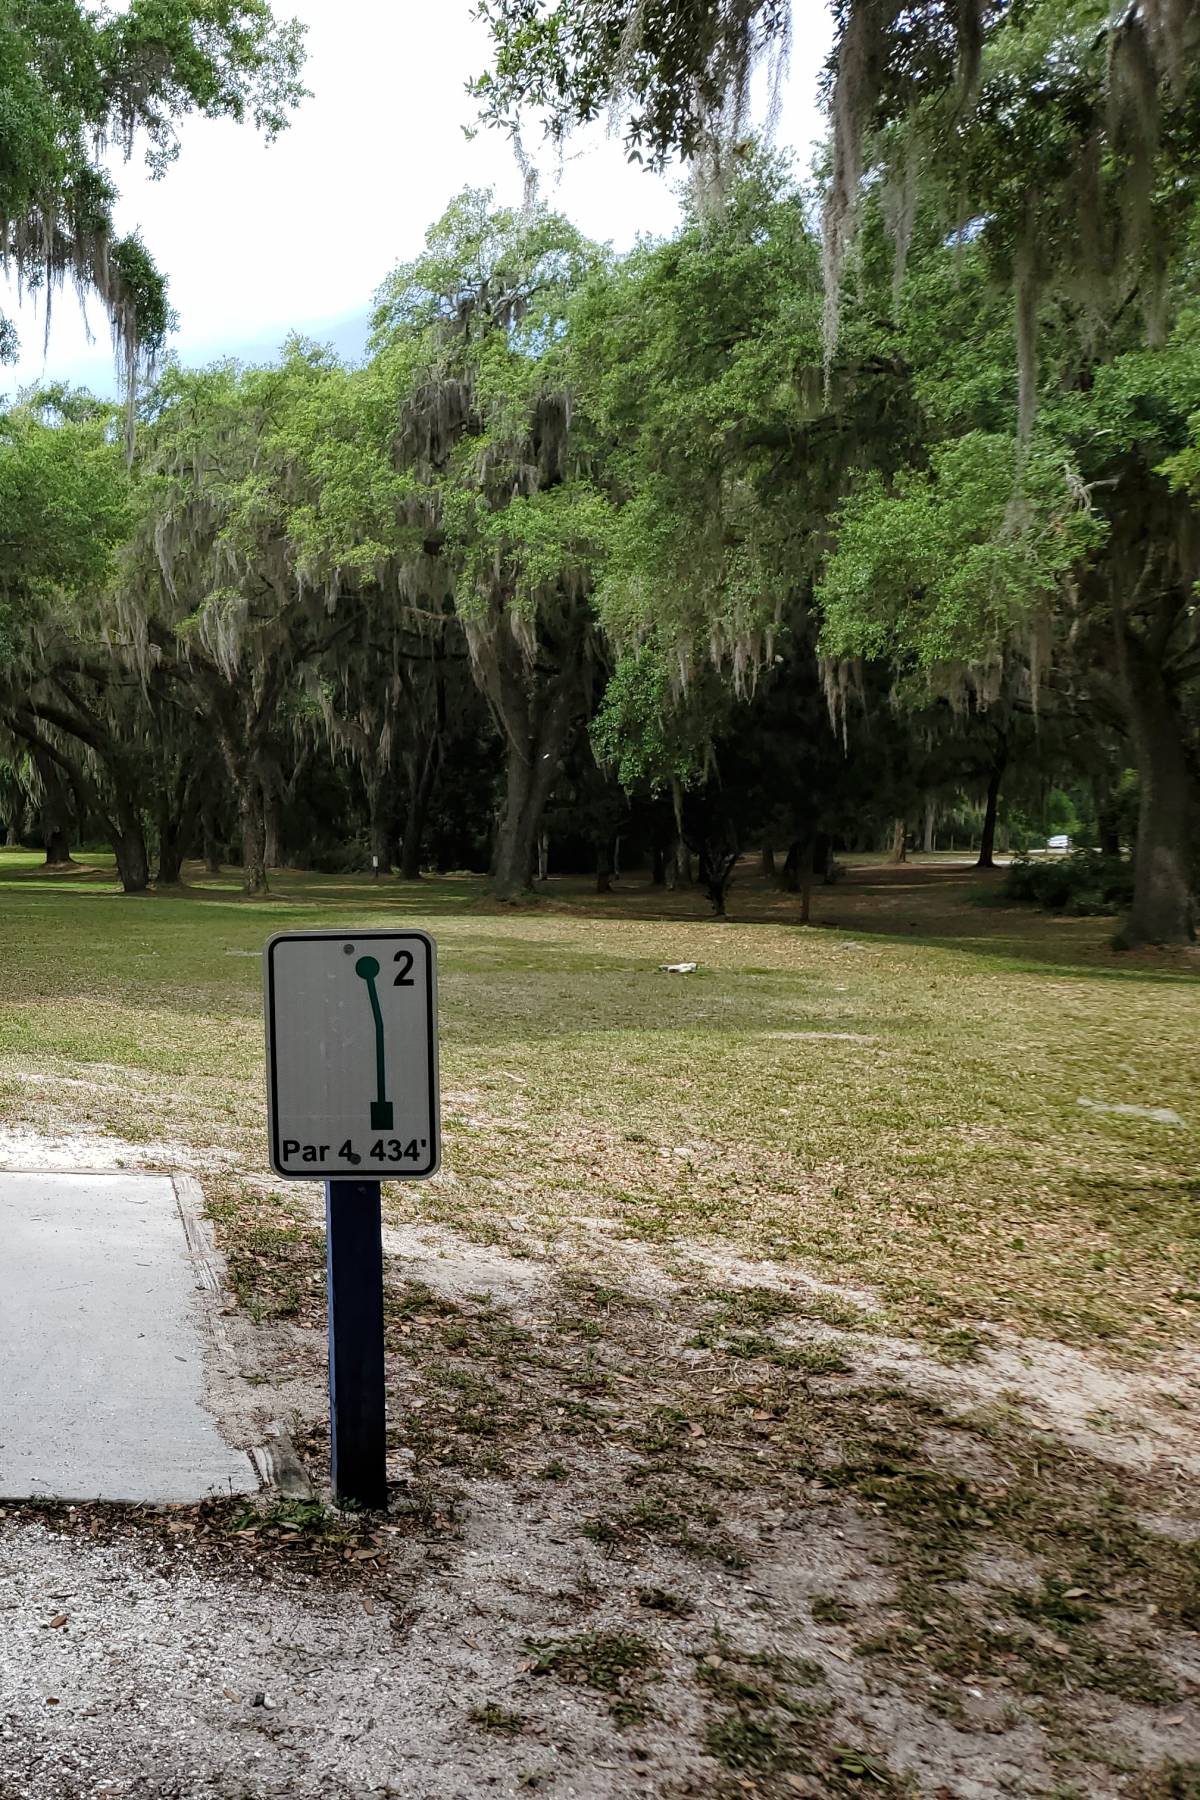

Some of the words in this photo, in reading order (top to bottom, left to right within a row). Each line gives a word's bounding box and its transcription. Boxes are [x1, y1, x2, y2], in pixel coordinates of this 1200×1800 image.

[393, 950, 415, 987] 2
[282, 1139, 330, 1162] Par
[369, 1139, 427, 1162] 434'
